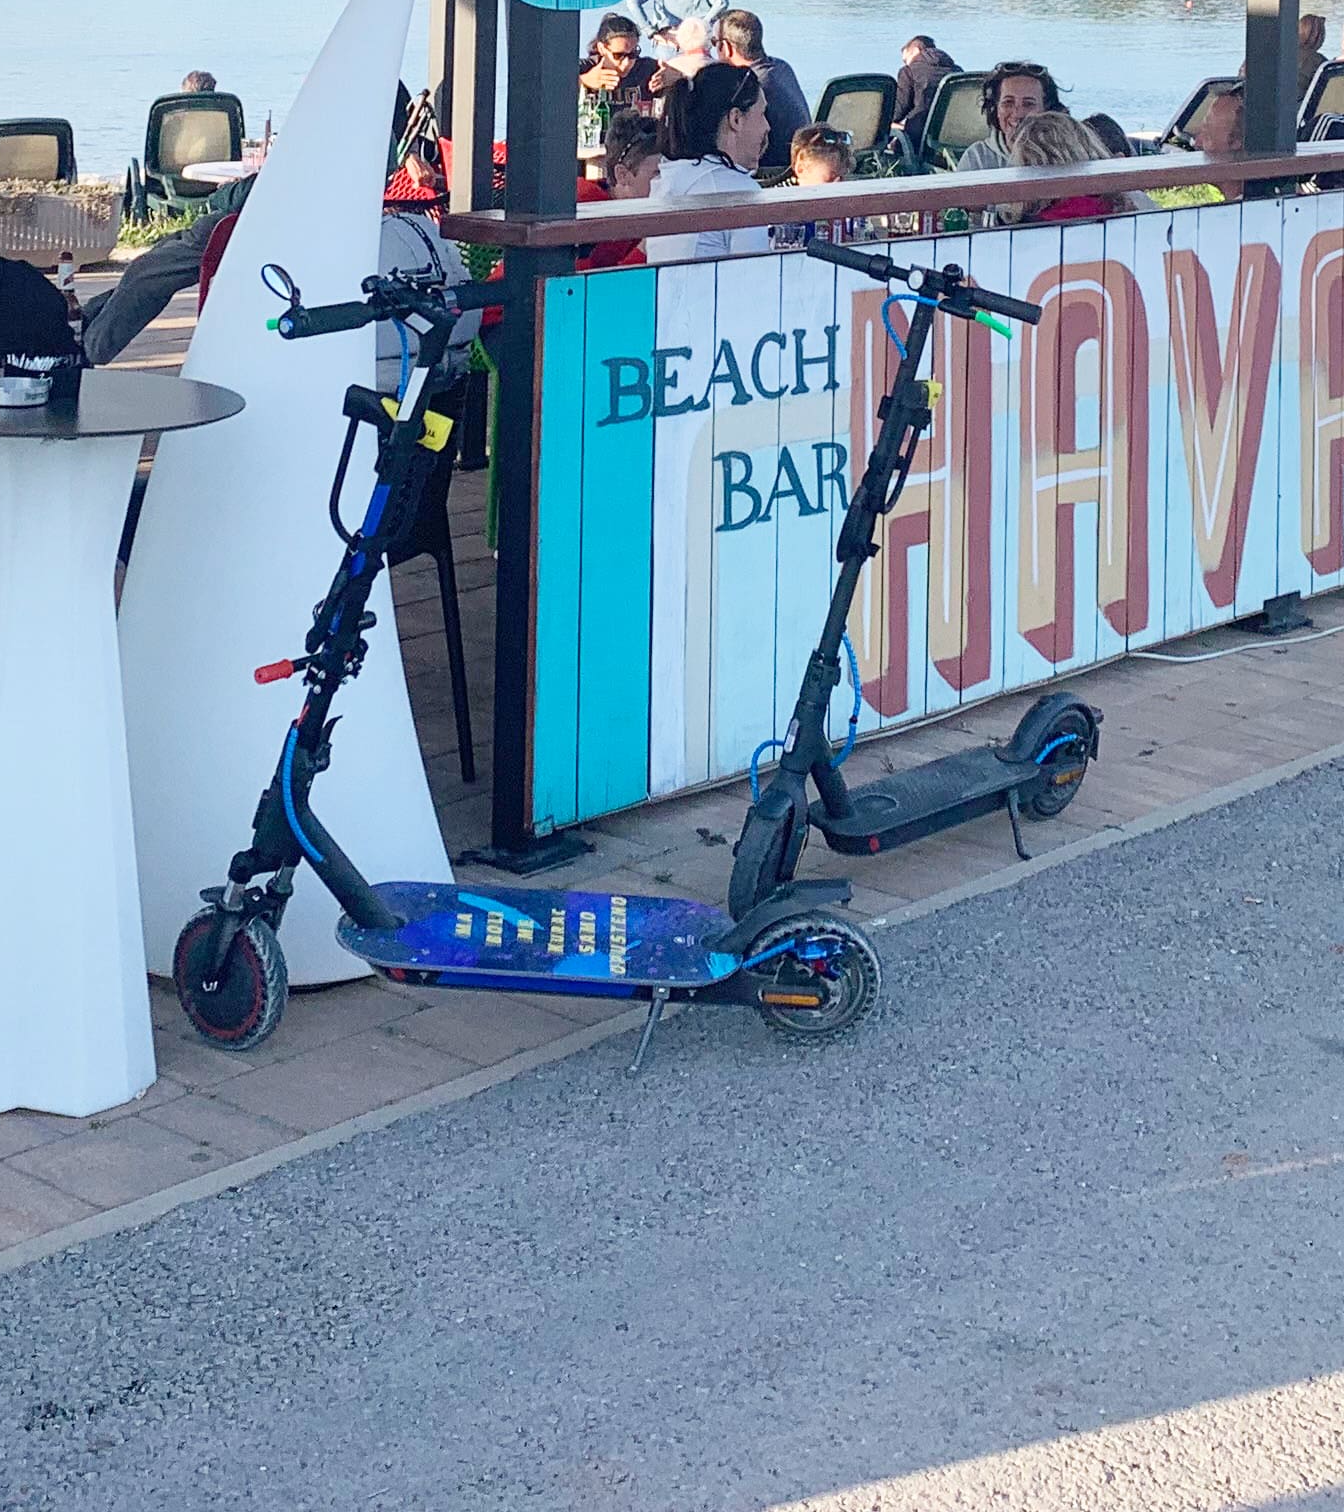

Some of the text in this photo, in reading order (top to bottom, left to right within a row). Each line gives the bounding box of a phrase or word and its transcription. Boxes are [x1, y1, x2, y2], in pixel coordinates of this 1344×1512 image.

[597, 325, 840, 427] BEACH
[713, 442, 850, 532] BAR
[455, 912, 472, 938] MA
[579, 911, 596, 955] SAMO
